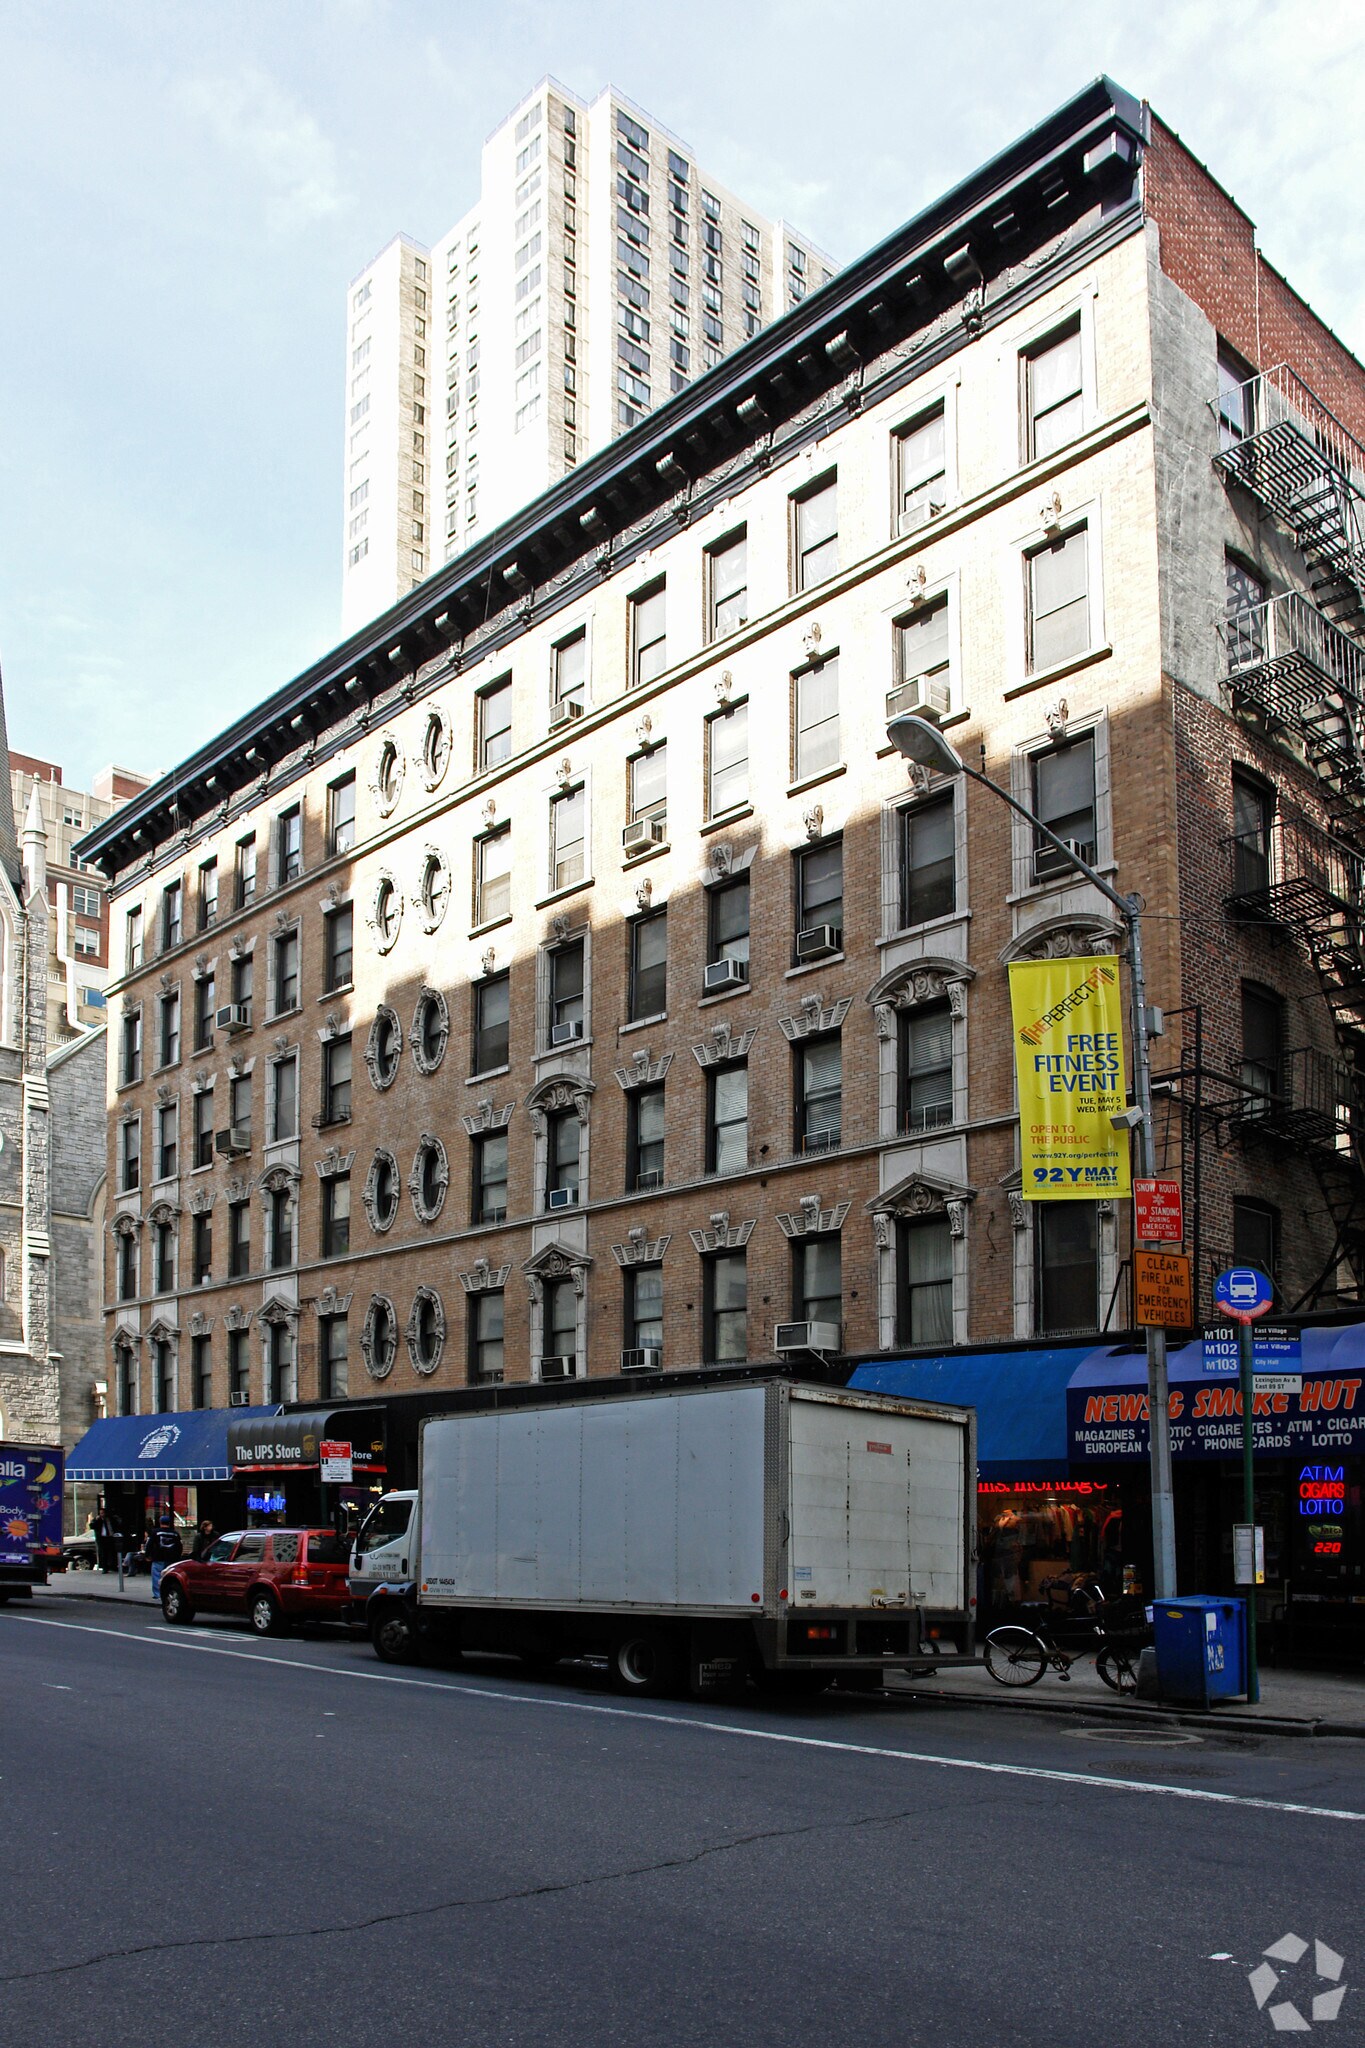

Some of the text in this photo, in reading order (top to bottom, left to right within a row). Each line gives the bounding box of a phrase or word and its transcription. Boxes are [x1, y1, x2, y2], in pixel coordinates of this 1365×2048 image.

[1067, 1033, 1119, 1052] FREE
[1034, 1053, 1119, 1072] FITNESS
[1049, 1073, 1119, 1092] EVENT
[1030, 1125, 1075, 1133] OPEN TO
[1030, 1135, 1090, 1144] THE PUBLIC
[1032, 1151, 1119, 1159] www.92Y.org/perfectfit
[1085, 1167, 1118, 1176] MAY
[1136, 1183, 1179, 1194] SNOW ROUTE
[1138, 1206, 1180, 1216] NO STANDING
[1147, 1258, 1179, 1272] CLEAR
[1141, 1271, 1185, 1287] FIRE LANE
[1158, 1286, 1170, 1294] FOR
[1138, 1294, 1188, 1310] EMERGENCY
[1222, 1302, 1268, 1316] NO STANDING
[1144, 1309, 1185, 1323] VEHICLES
[1204, 1328, 1234, 1340] M101
[1205, 1343, 1238, 1355] M102
[1270, 1343, 1291, 1351] Village
[1206, 1359, 1237, 1371] M103
[1168, 1391, 1184, 1419] &
[1299, 1379, 1362, 1412] HUT
[1075, 1429, 1135, 1441] MAGAZINES
[1287, 1420, 1312, 1433] ATM
[1085, 1442, 1142, 1454] EUROPEAN
[1204, 1437, 1243, 1450] PHONE
[1252, 1435, 1291, 1448] CARDS
[1312, 1433, 1352, 1447] LOTTO
[236, 1444, 301, 1460] The UPS Store
[1299, 1465, 1344, 1481] ATM
[1300, 1483, 1345, 1498] CIGARS
[1300, 1499, 1344, 1515] LOTTO
[1314, 1542, 1341, 1553] 220
